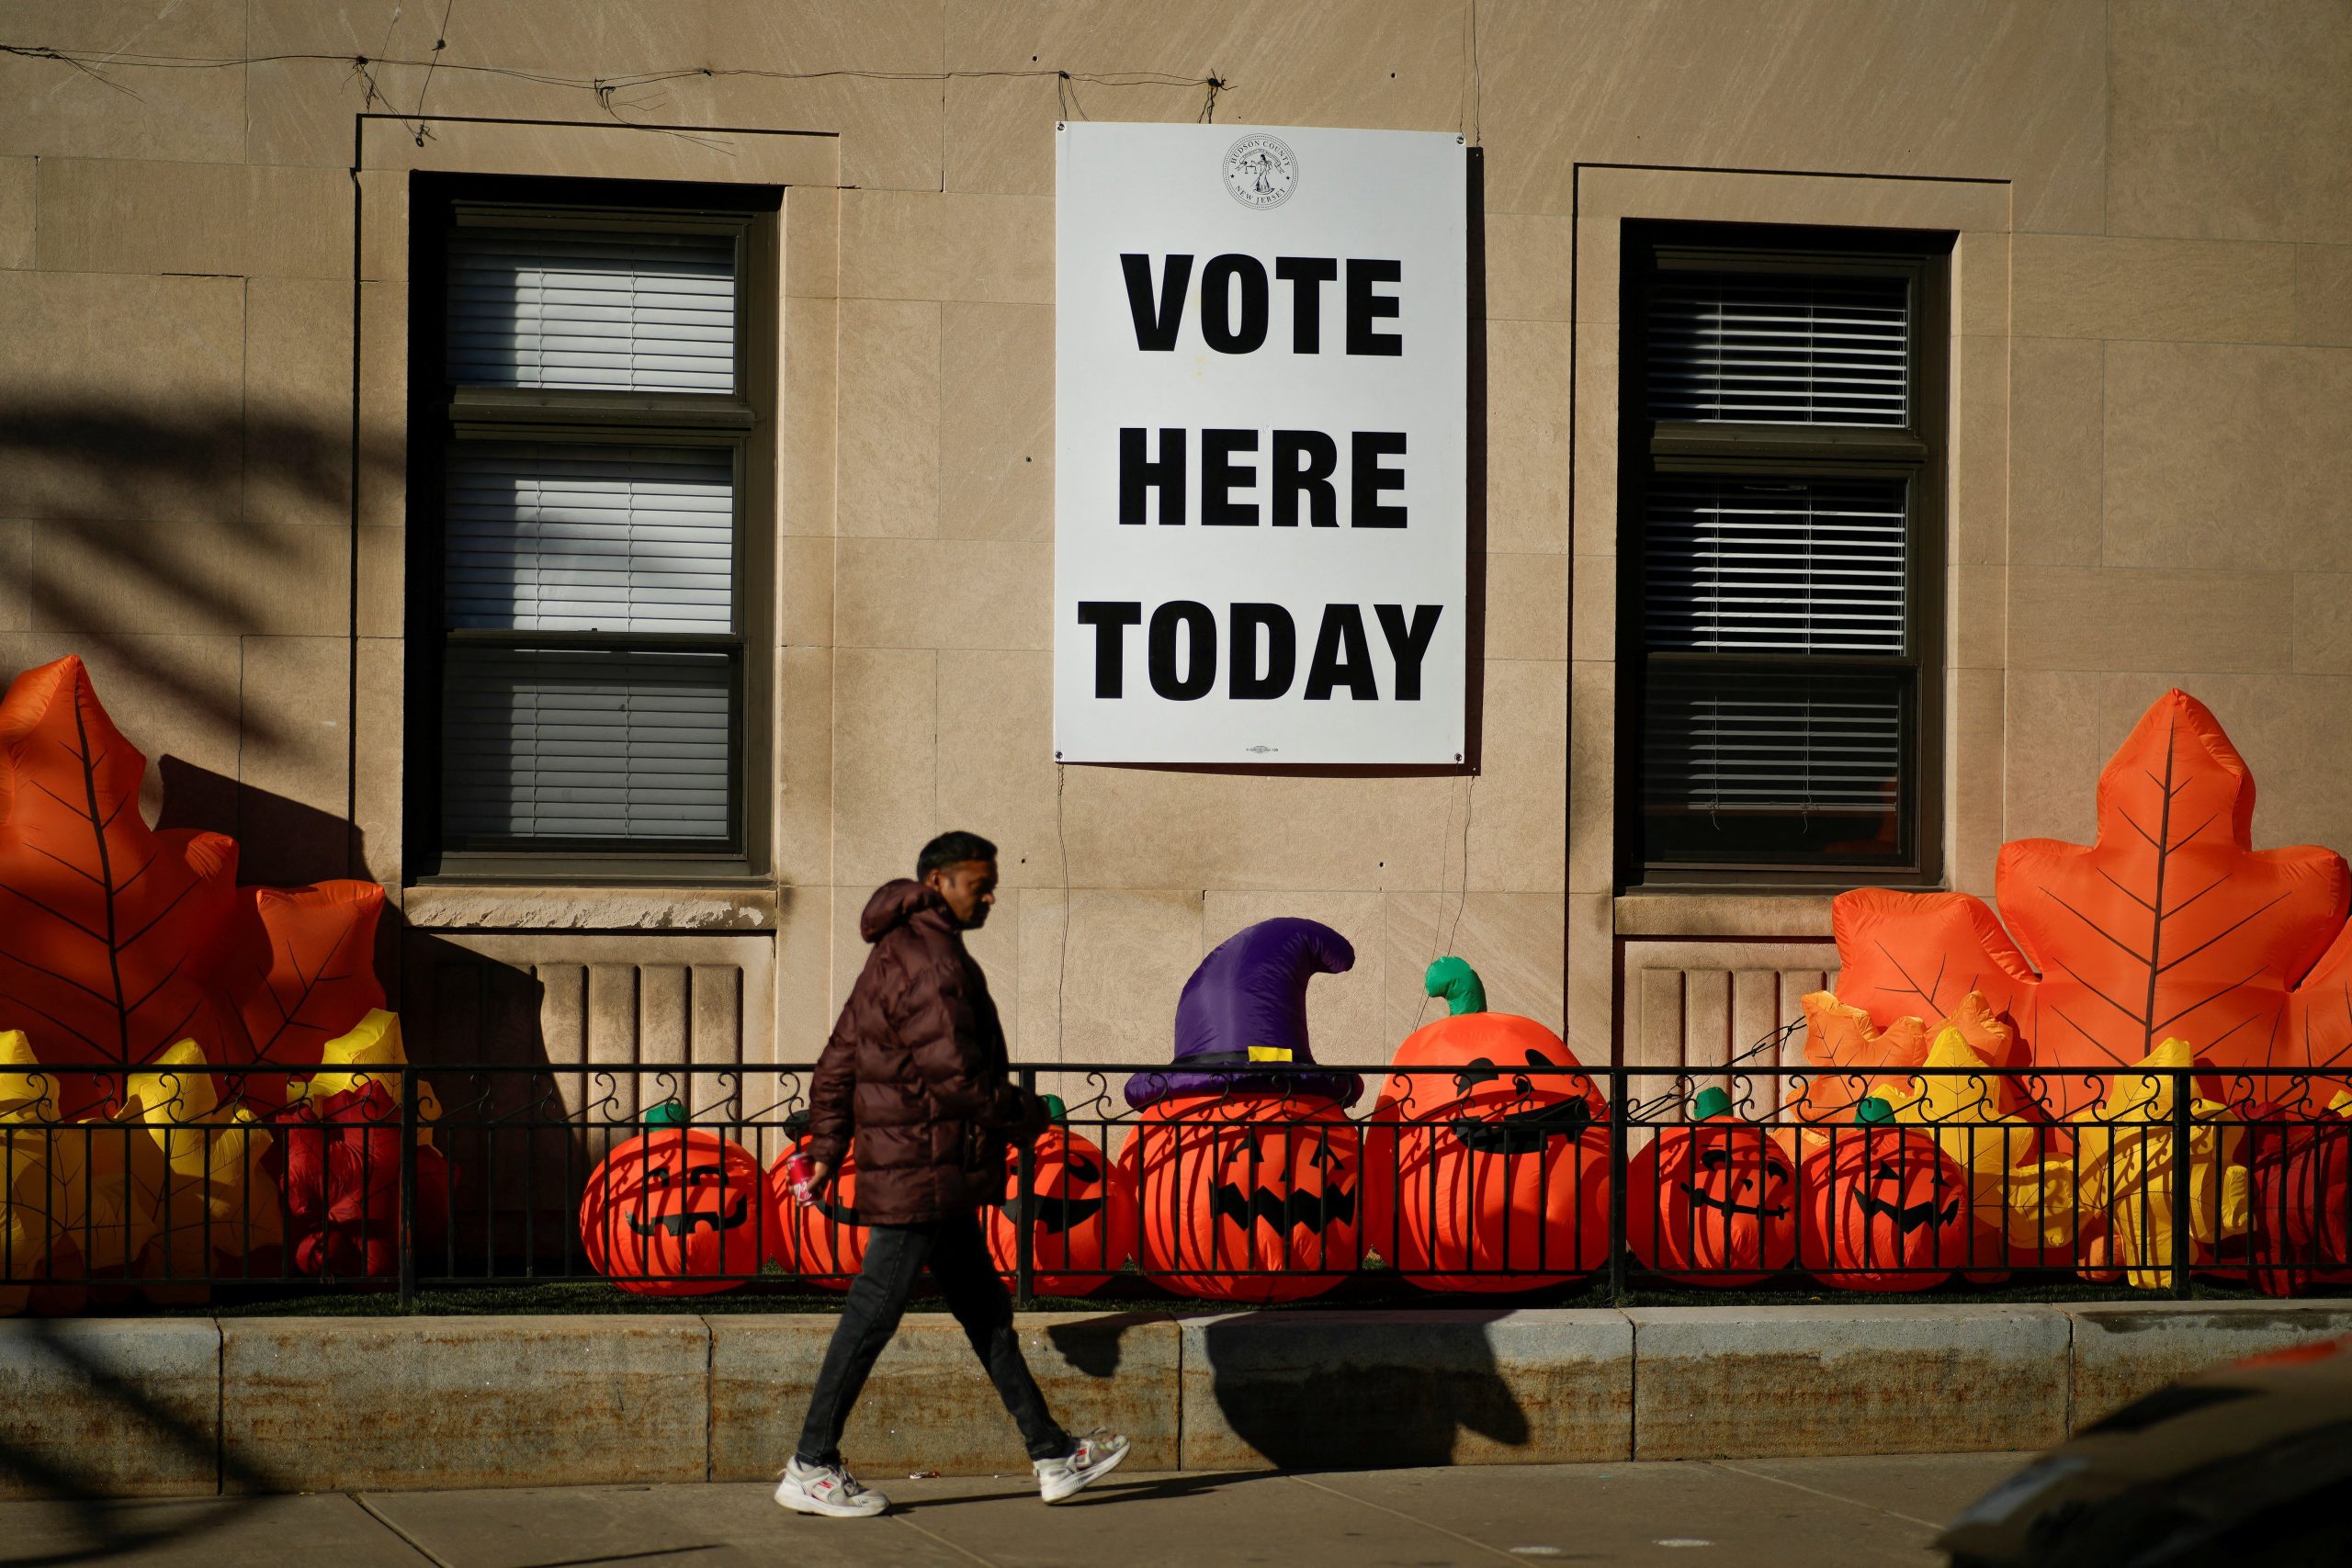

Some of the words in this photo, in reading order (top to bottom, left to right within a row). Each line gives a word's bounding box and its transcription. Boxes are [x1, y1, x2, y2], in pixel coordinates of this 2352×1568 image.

[1230, 141, 1261, 164] HUDSON
[1262, 141, 1291, 167] COUNTY
[1235, 185, 1254, 200] NEW
[1256, 186, 1285, 205] JERSEY
[1119, 253, 1403, 357] VOTE
[1118, 427, 1408, 529] HERE
[1077, 600, 1444, 702] TODAY
